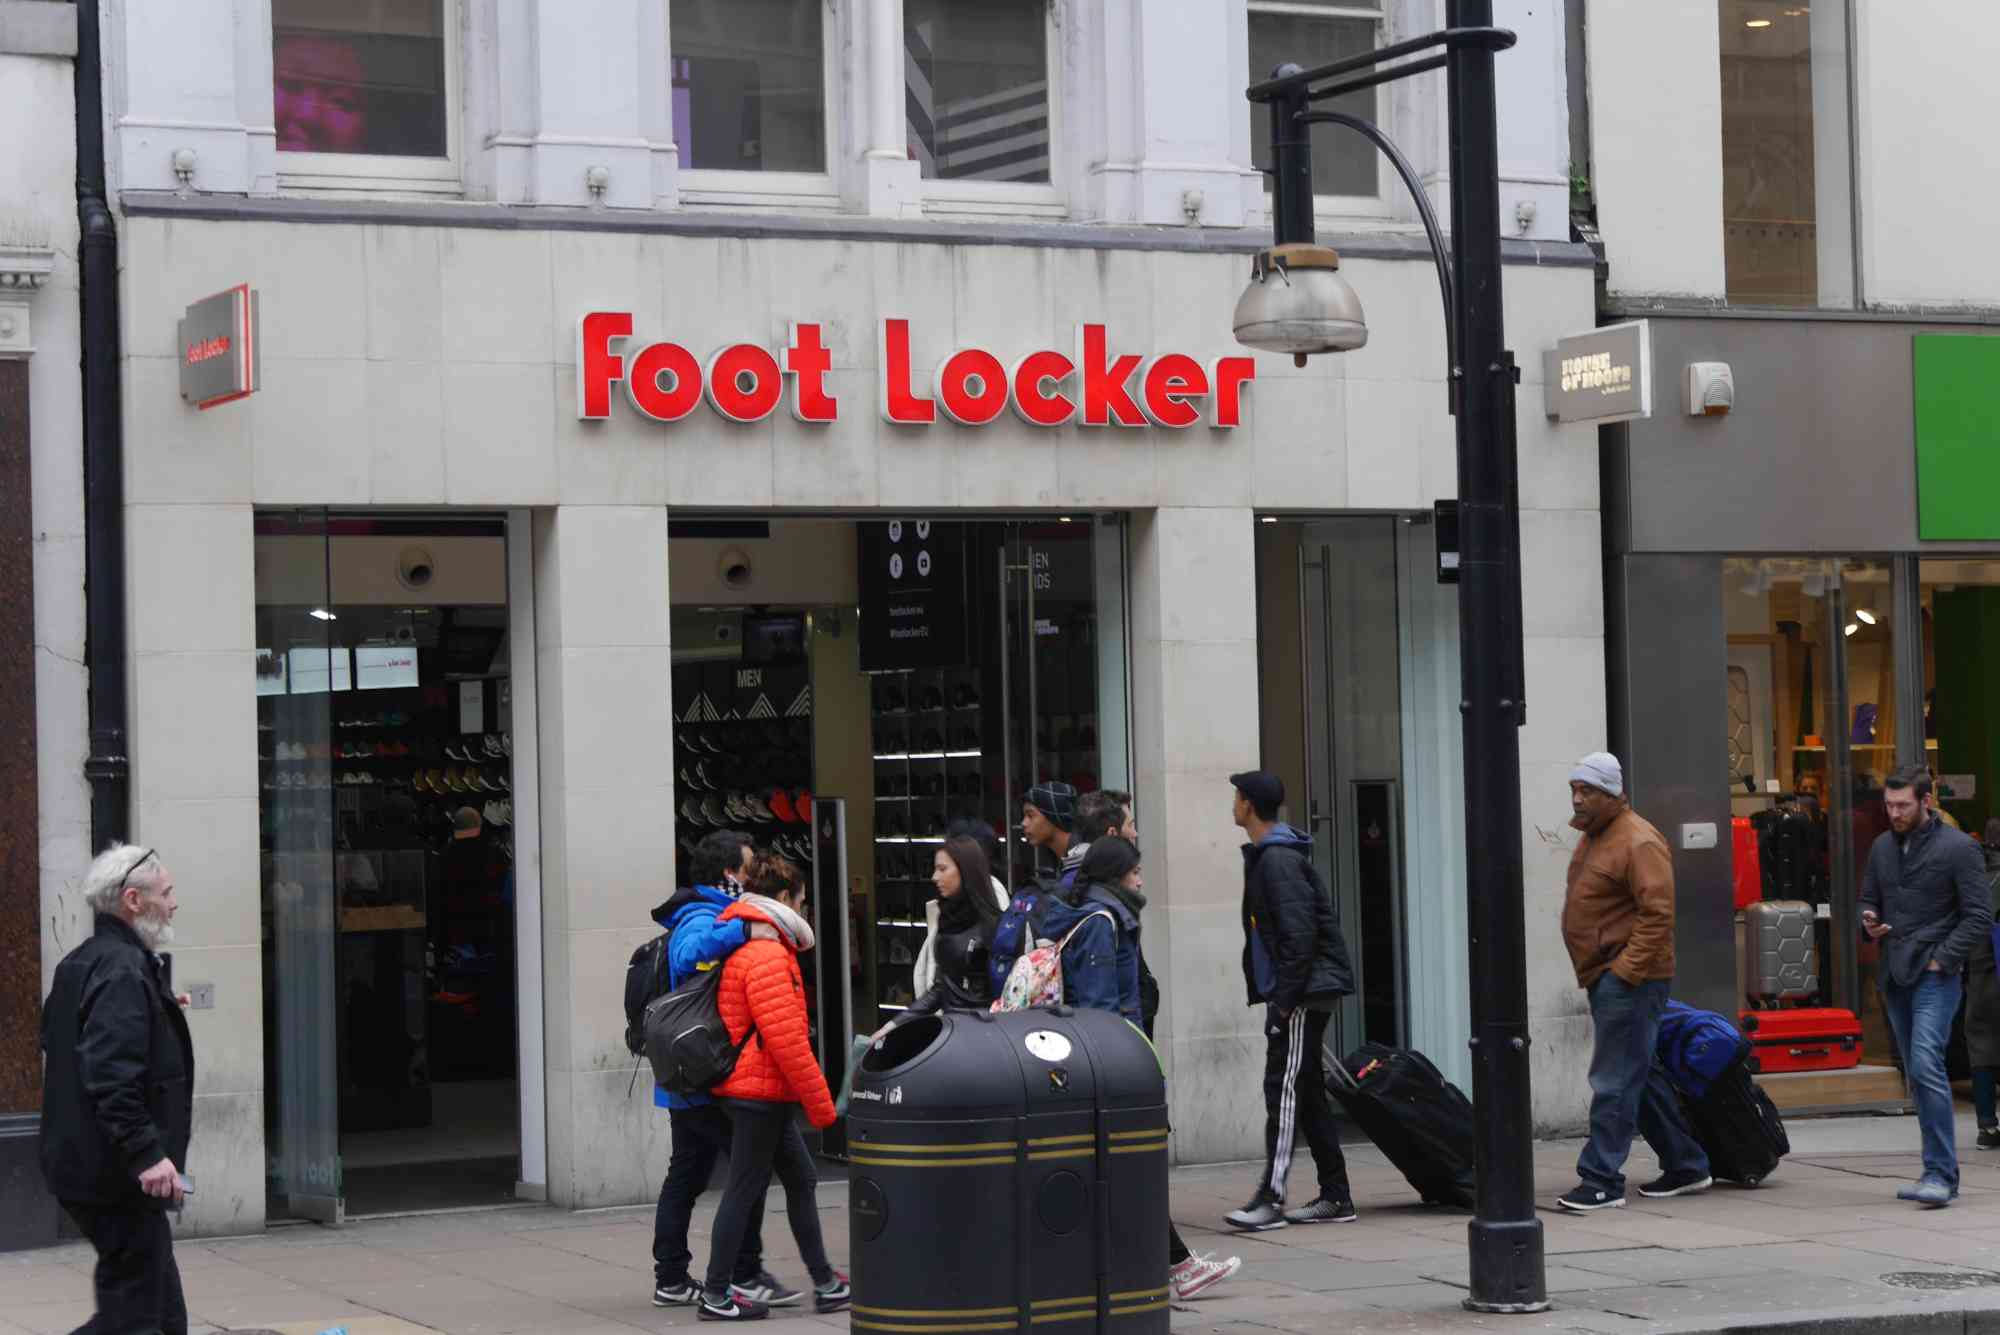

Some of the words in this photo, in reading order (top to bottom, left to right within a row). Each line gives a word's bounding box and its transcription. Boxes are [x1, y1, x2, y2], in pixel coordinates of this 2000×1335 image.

[579, 311, 838, 422] Foot
[879, 318, 1256, 428] Locker
[737, 668, 762, 689] MEN
